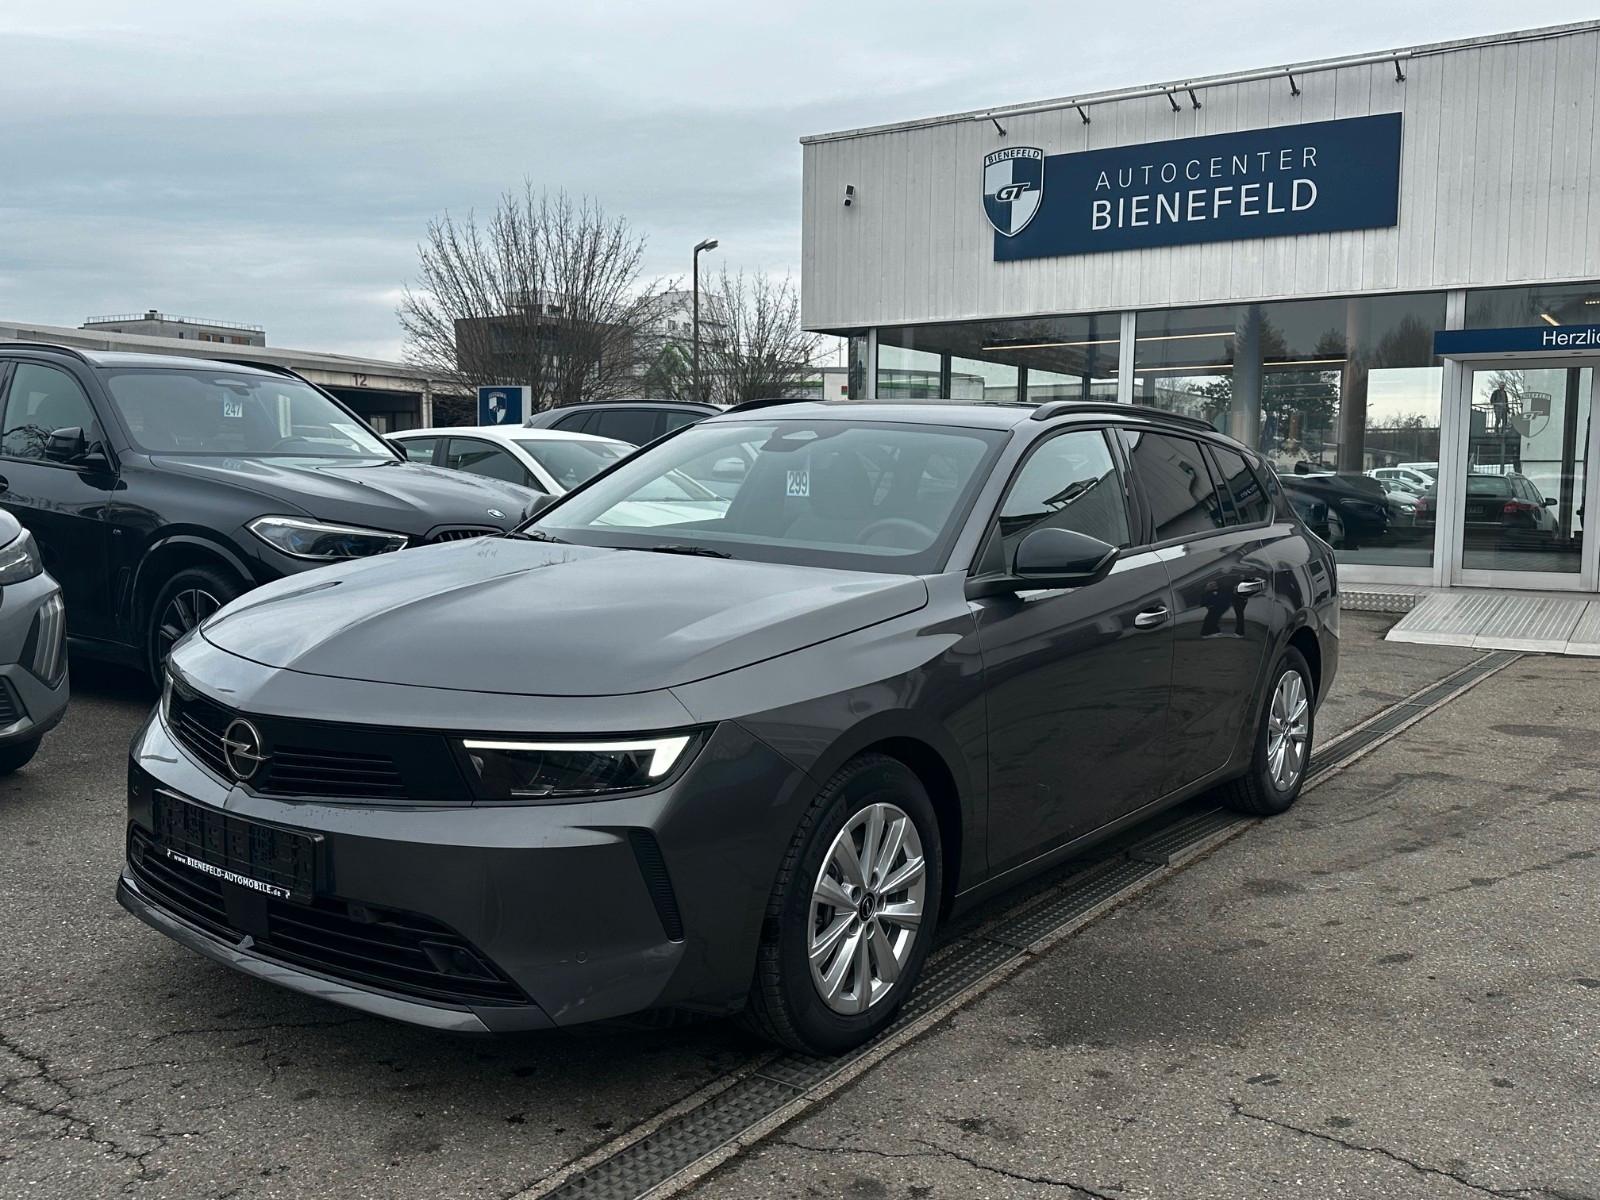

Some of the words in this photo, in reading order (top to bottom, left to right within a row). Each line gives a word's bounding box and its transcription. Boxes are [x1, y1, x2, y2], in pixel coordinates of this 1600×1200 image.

[988, 149, 1040, 163] BIENEFELD
[1095, 146, 1317, 192] AUTOCENTER
[995, 182, 1031, 202] GT
[1091, 178, 1318, 231] BIENEFELD
[352, 374, 368, 387] 12
[788, 470, 808, 495] 299
[173, 854, 281, 897] www.BIENEFELD-AUTOMOBILE.de
